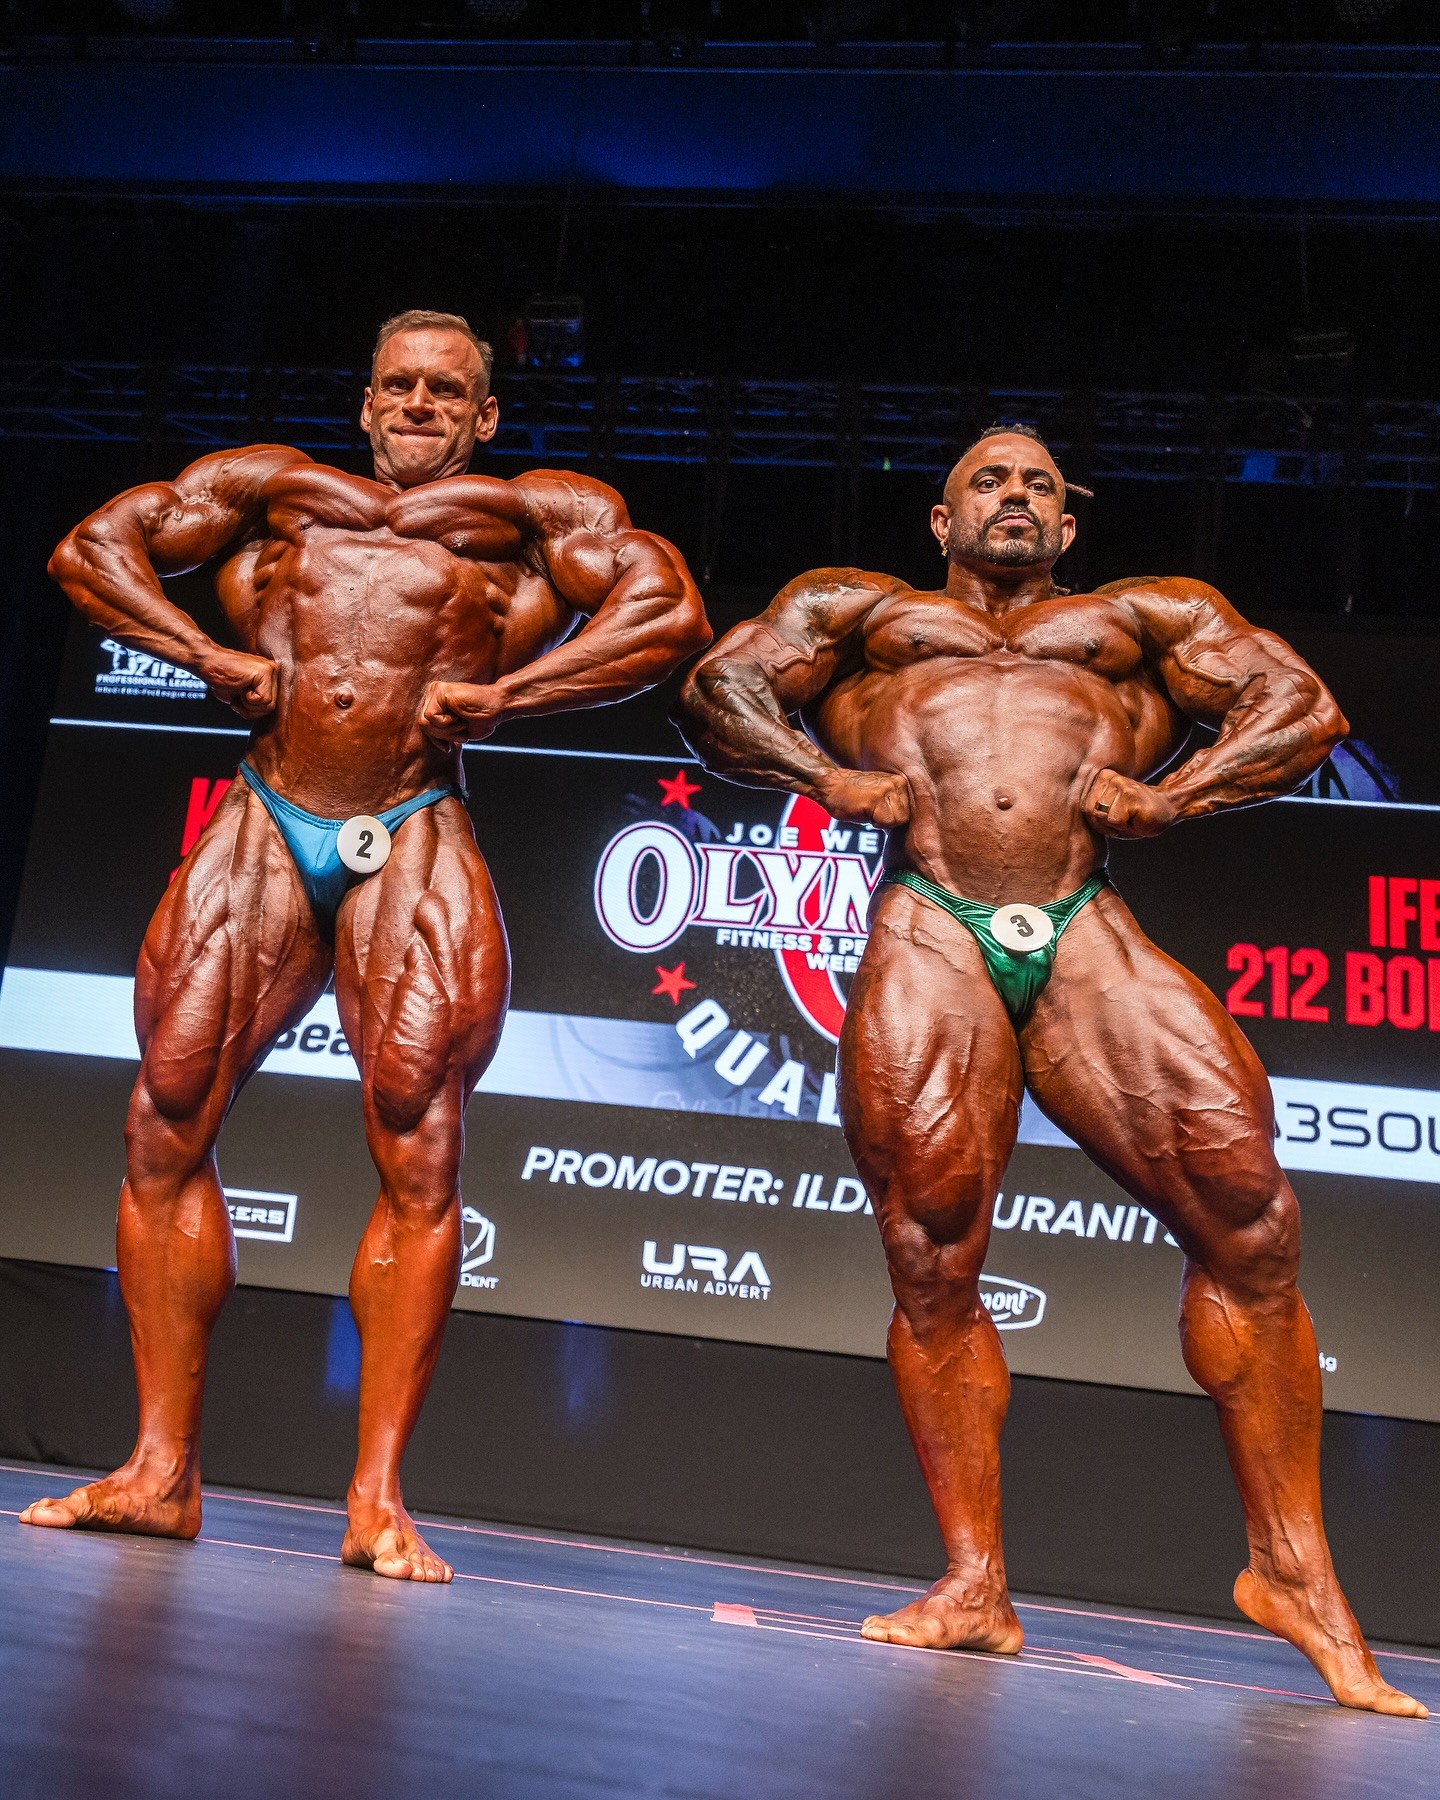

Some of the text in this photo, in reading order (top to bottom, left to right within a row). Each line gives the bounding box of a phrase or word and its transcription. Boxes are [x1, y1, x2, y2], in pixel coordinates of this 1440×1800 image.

[96, 674, 208, 689] PROFESSIONAL LEAGUE
[356, 830, 374, 859] 2
[725, 822, 799, 848] JOE
[1010, 914, 1034, 938] 3
[716, 928, 813, 952] FITNESS
[817, 935, 834, 954] &
[1226, 943, 1330, 1023] 212
[521, 1146, 784, 1206] PROMOTER:
[792, 1173, 874, 1215] ILD
[642, 1240, 771, 1286] URA
[460, 1272, 500, 1289] DENT
[640, 1273, 771, 1300] URBAN ADVERT
